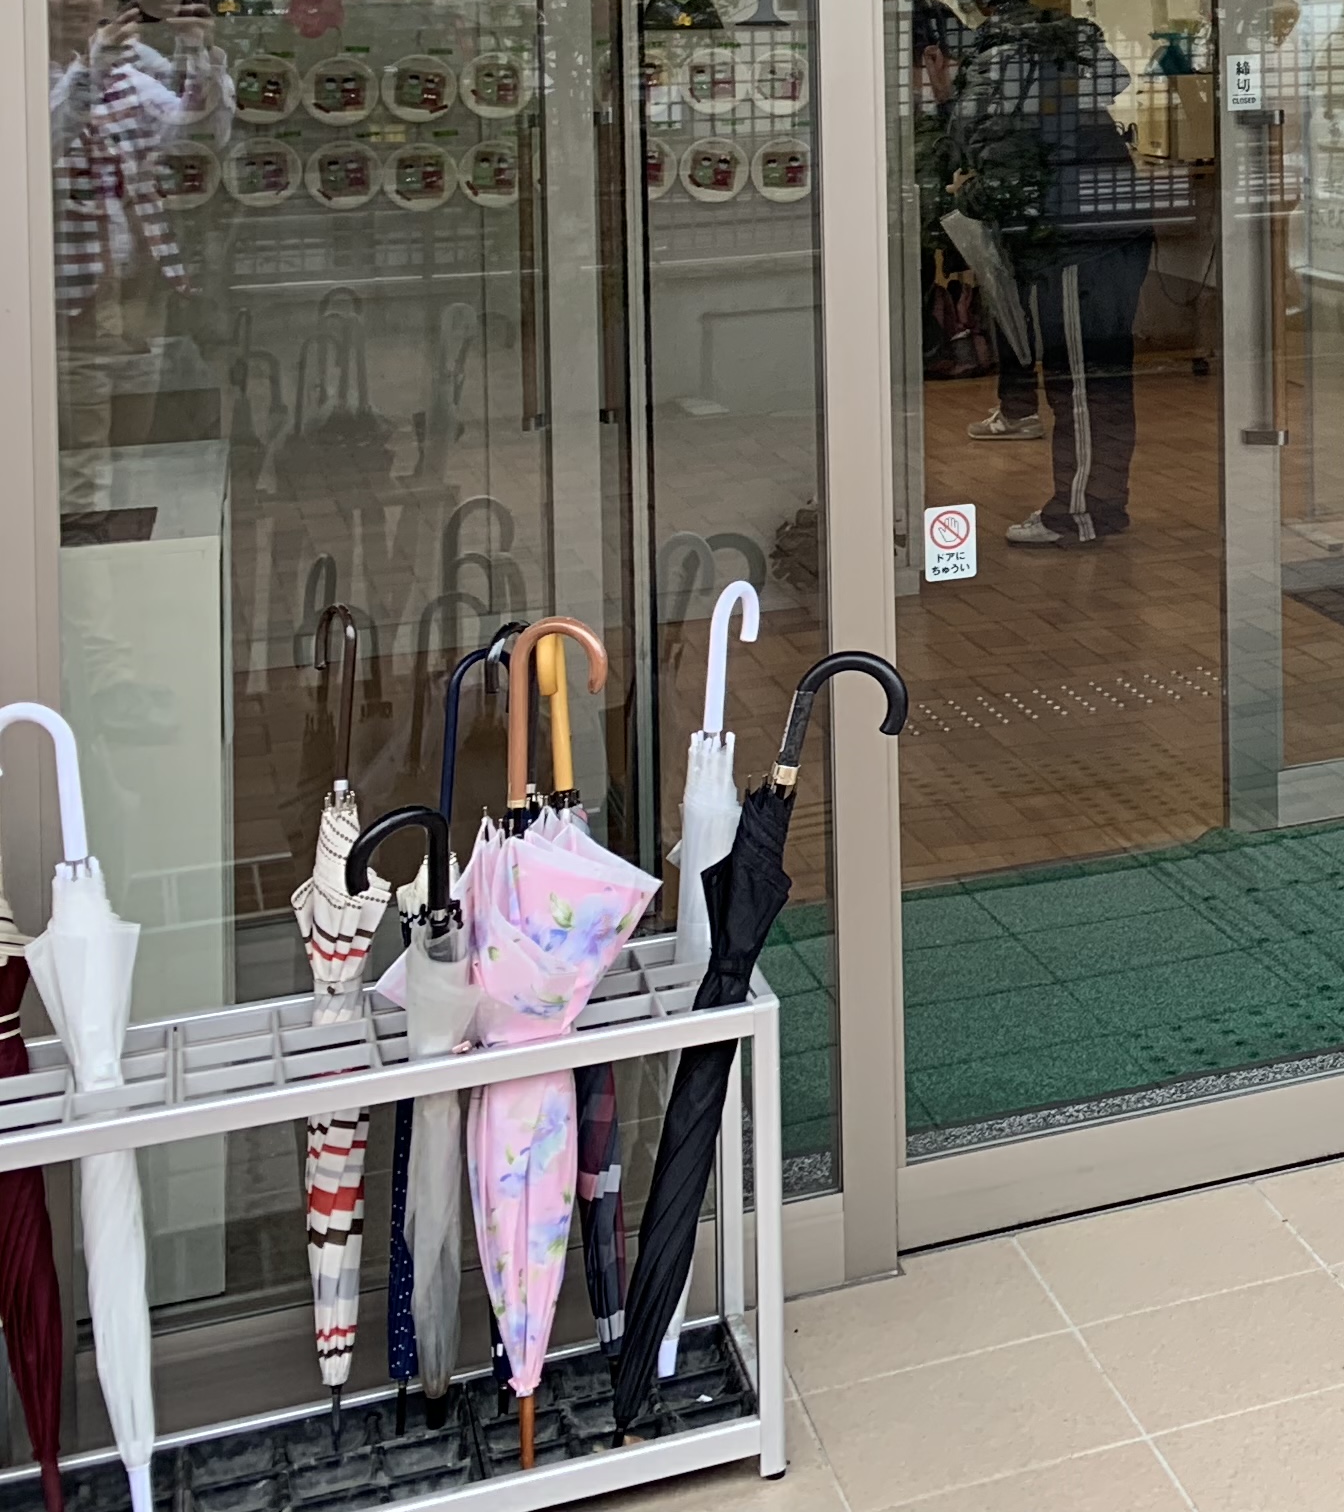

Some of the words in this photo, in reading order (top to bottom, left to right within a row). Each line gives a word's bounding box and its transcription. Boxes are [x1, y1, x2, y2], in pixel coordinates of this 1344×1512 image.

[937, 551, 966, 564] ドアに
[931, 563, 971, 576] ちゅうい
